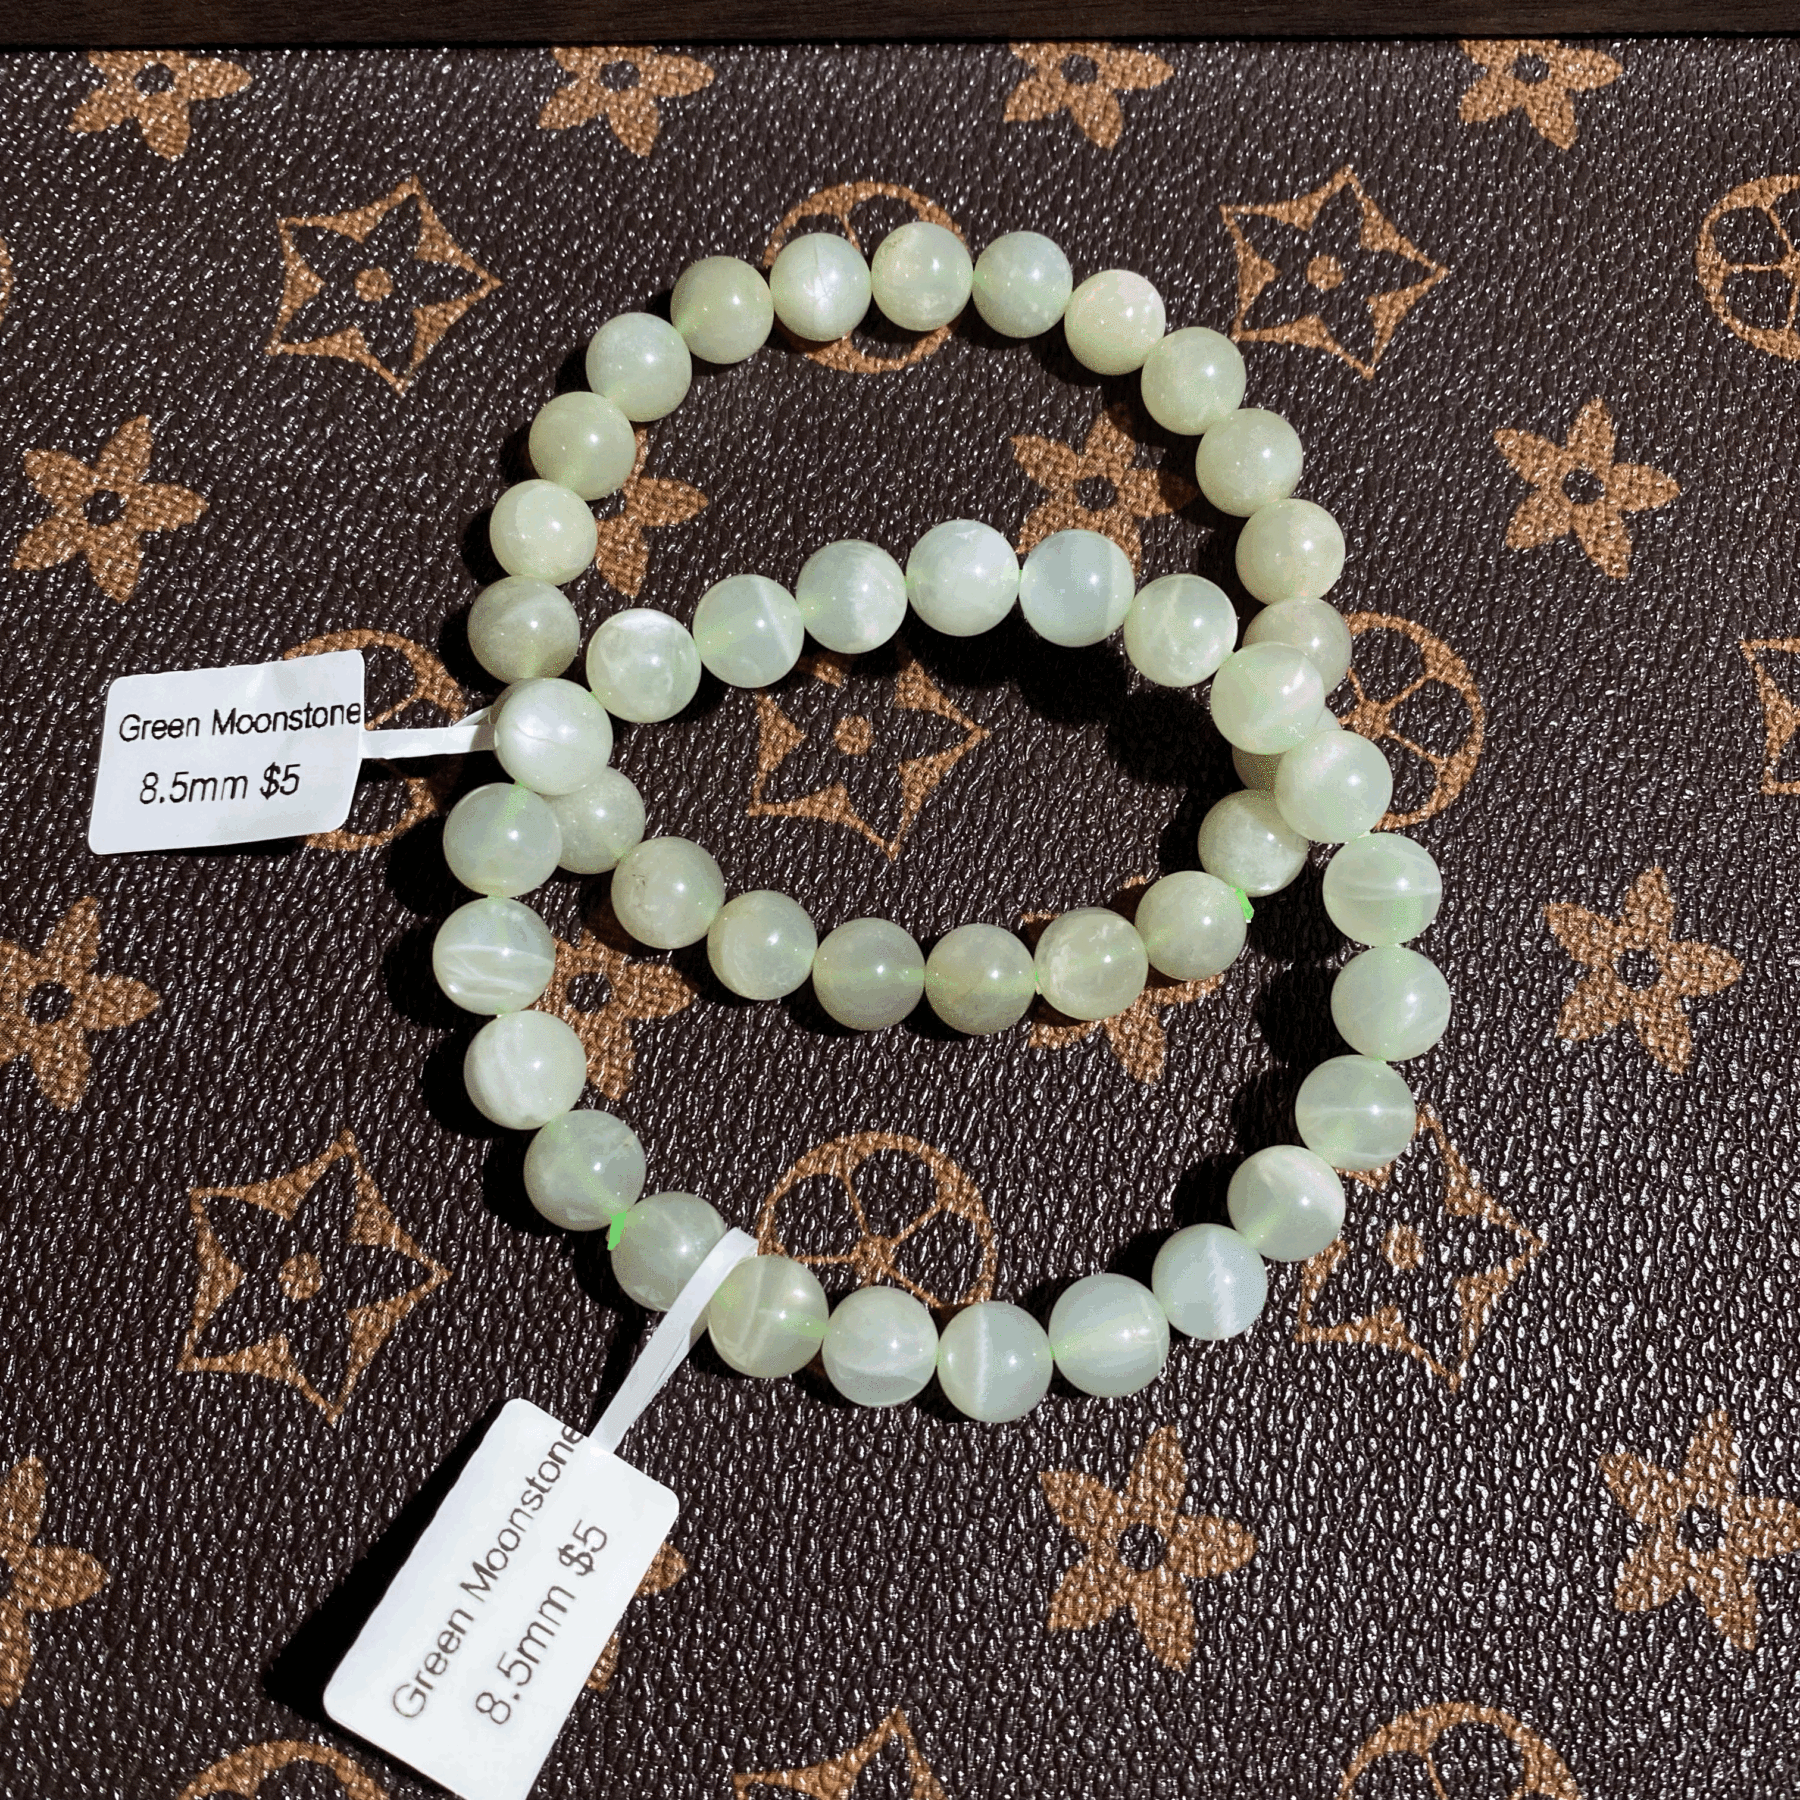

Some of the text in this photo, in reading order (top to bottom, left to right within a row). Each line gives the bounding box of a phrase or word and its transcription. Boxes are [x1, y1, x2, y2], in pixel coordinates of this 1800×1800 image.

[119, 702, 361, 742] Green Moonstone
[139, 761, 301, 804] 8.5mm $5
[392, 1425, 584, 1718] Green Moonstone
[475, 1519, 608, 1725] 8.5mm $5
